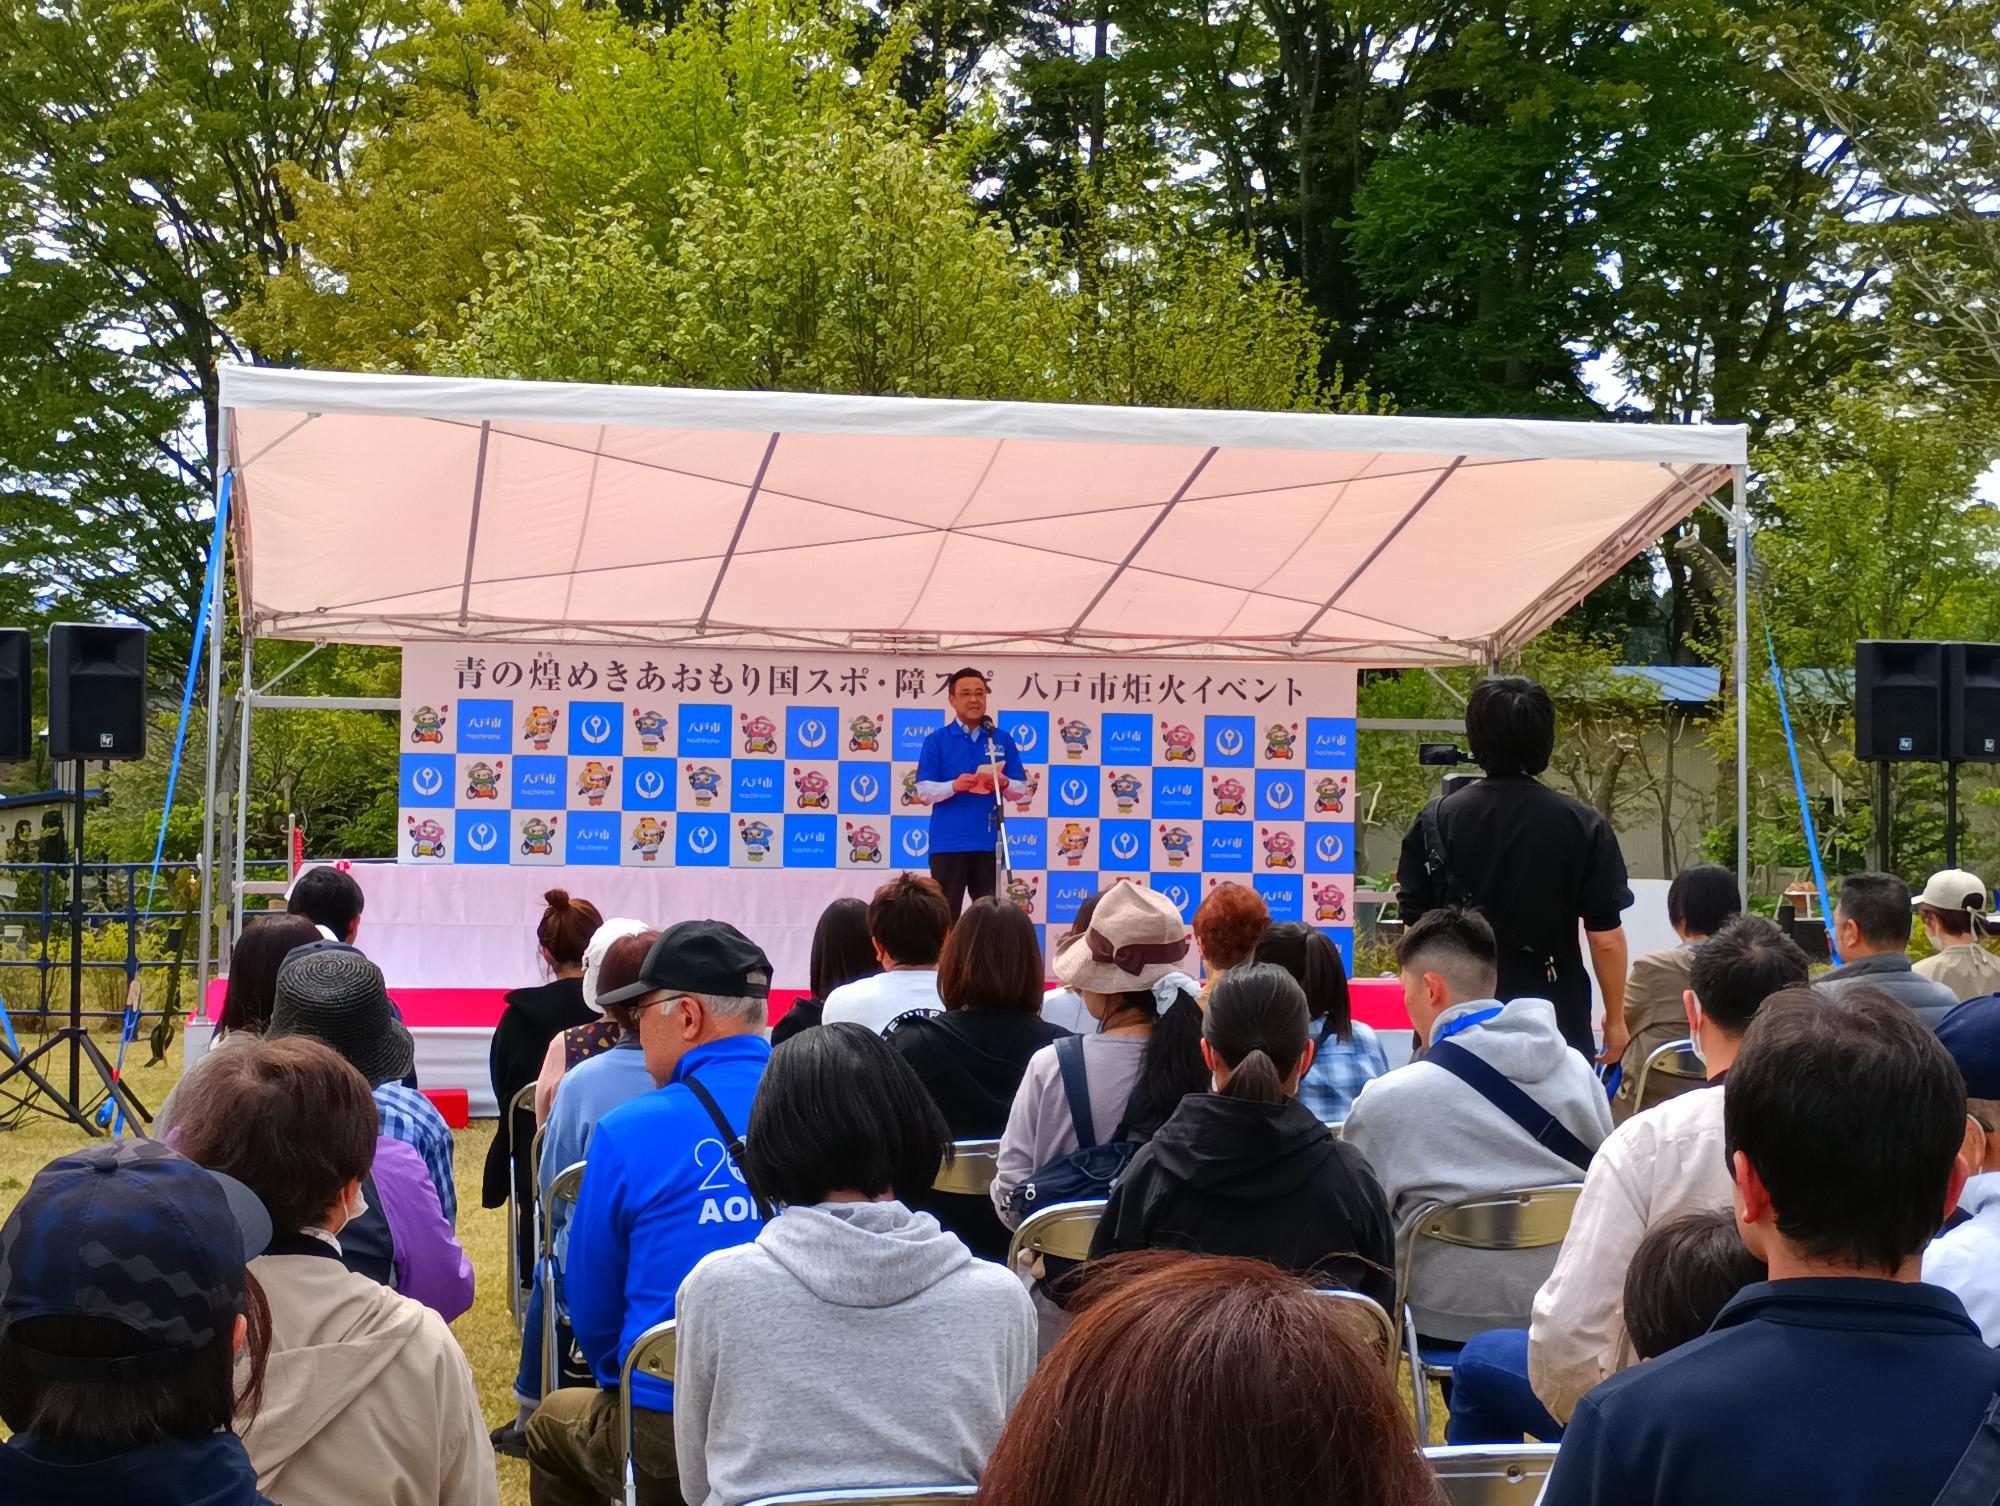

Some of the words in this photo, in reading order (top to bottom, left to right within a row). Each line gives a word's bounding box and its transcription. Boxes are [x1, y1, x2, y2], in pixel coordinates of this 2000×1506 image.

[1016, 671, 1304, 706] 八戸市炬火イベント
